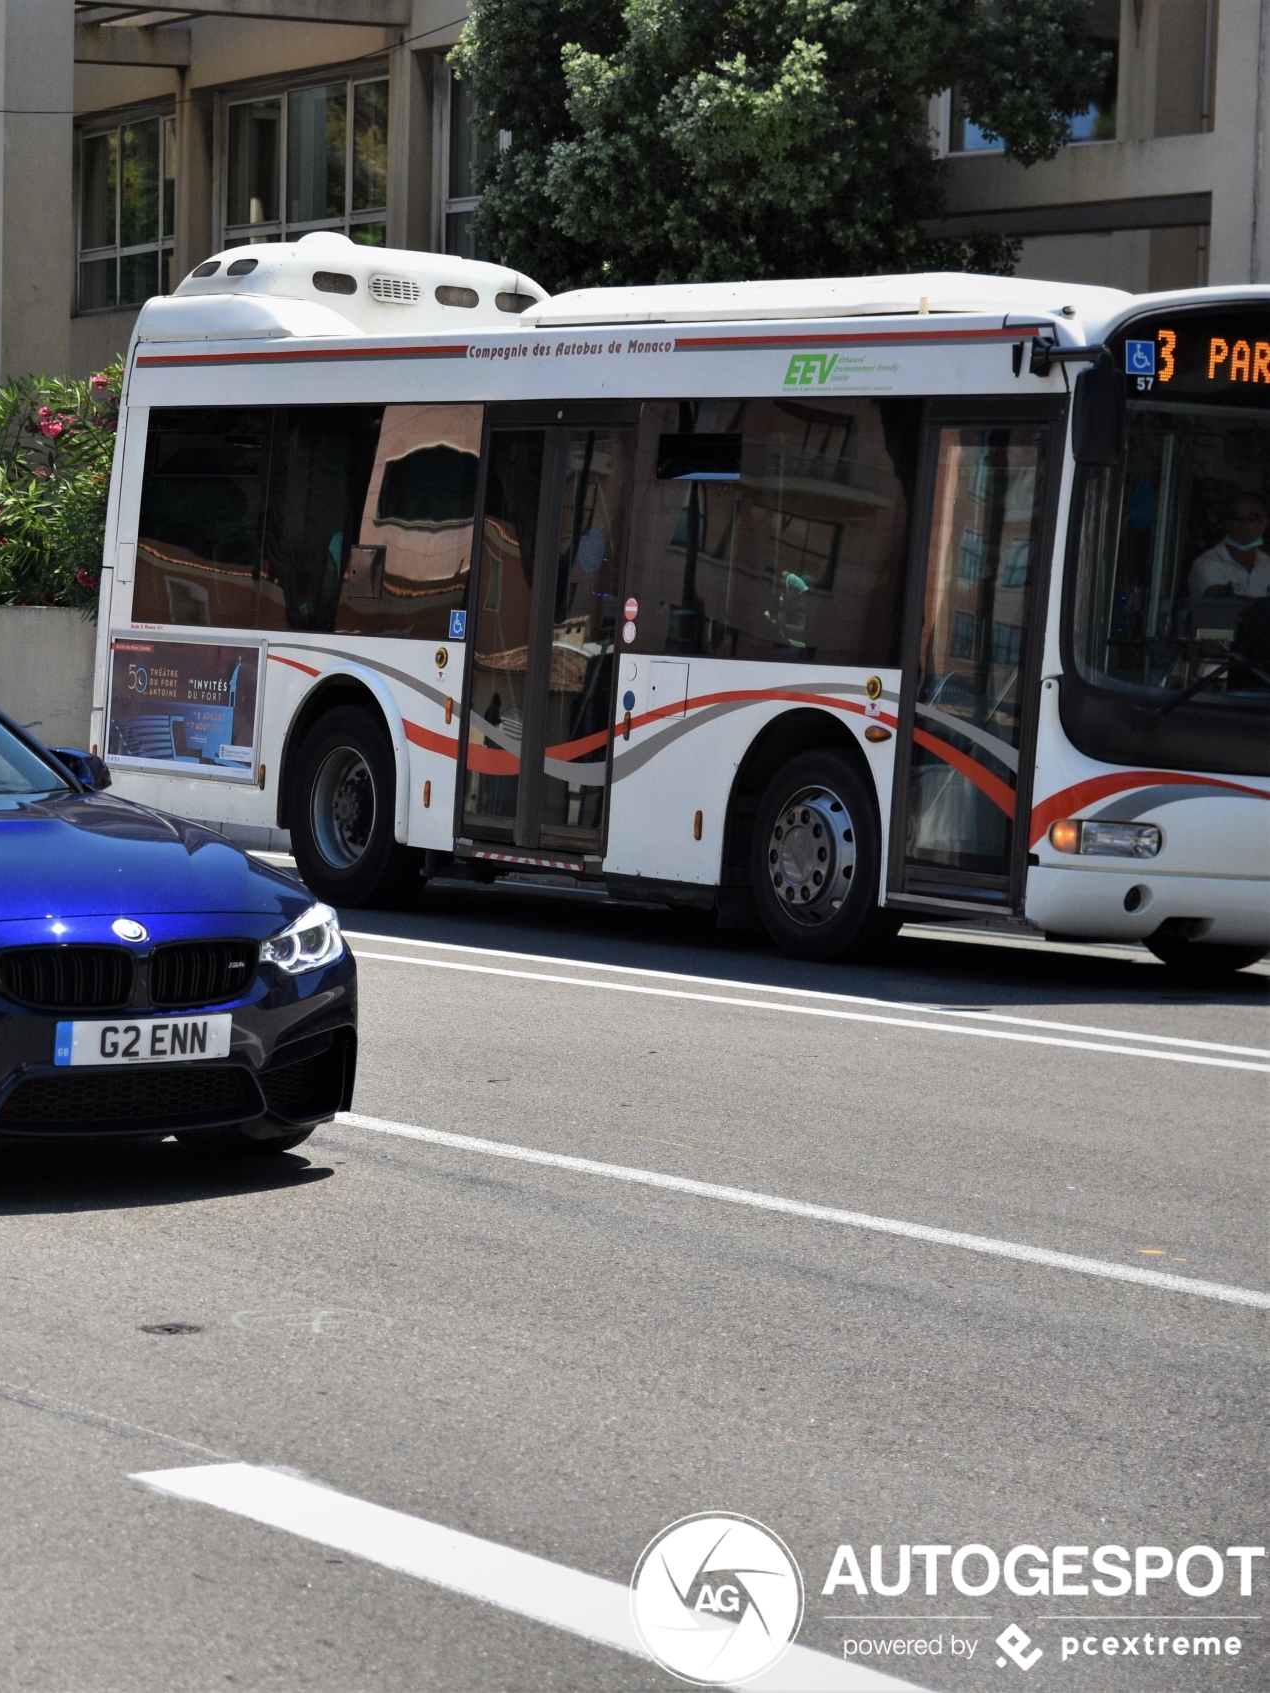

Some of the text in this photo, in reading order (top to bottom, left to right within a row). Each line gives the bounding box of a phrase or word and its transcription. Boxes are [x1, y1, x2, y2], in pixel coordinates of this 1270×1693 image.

[469, 340, 672, 360] Compagnie des Autobus de Monaco
[1158, 329, 1270, 384] 3 PAR
[783, 353, 840, 385] EEV
[1136, 376, 1154, 391] 57
[150, 667, 179, 678] THÉÂTRE
[149, 678, 178, 687] DU FORT
[193, 678, 228, 692] INVITÉS
[149, 688, 178, 698] ANTOINE
[187, 691, 222, 702] DU FORT
[202, 712, 226, 722] JUILLET
[195, 721, 211, 731] AOÛT
[57, 1021, 208, 1059] GB G2 ENN
